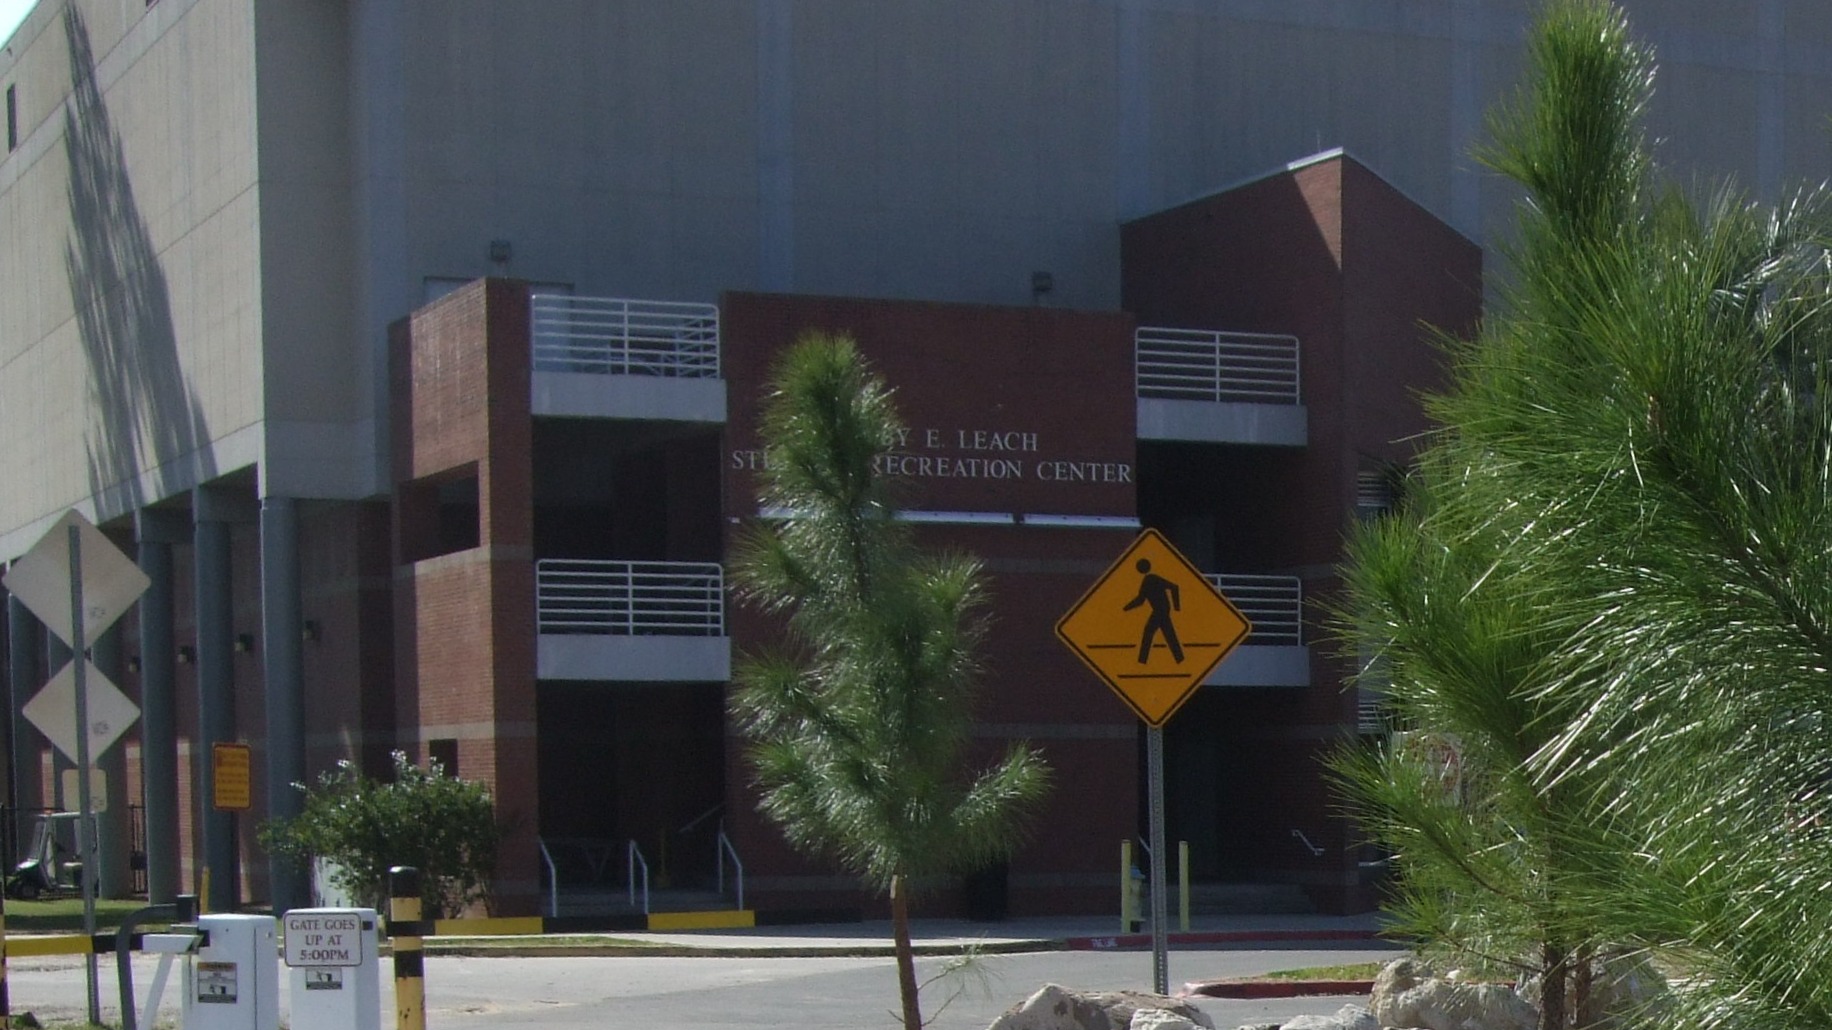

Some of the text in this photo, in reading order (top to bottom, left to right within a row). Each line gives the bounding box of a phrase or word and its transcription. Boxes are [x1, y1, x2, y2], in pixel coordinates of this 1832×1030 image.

[926, 429, 945, 448] E.
[958, 430, 1038, 451] LEACH
[872, 453, 1132, 483] RECREATION CENTER
[290, 920, 355, 930] GATE GOES
[305, 935, 342, 946] UP AT
[299, 949, 349, 961] 5:00PM
